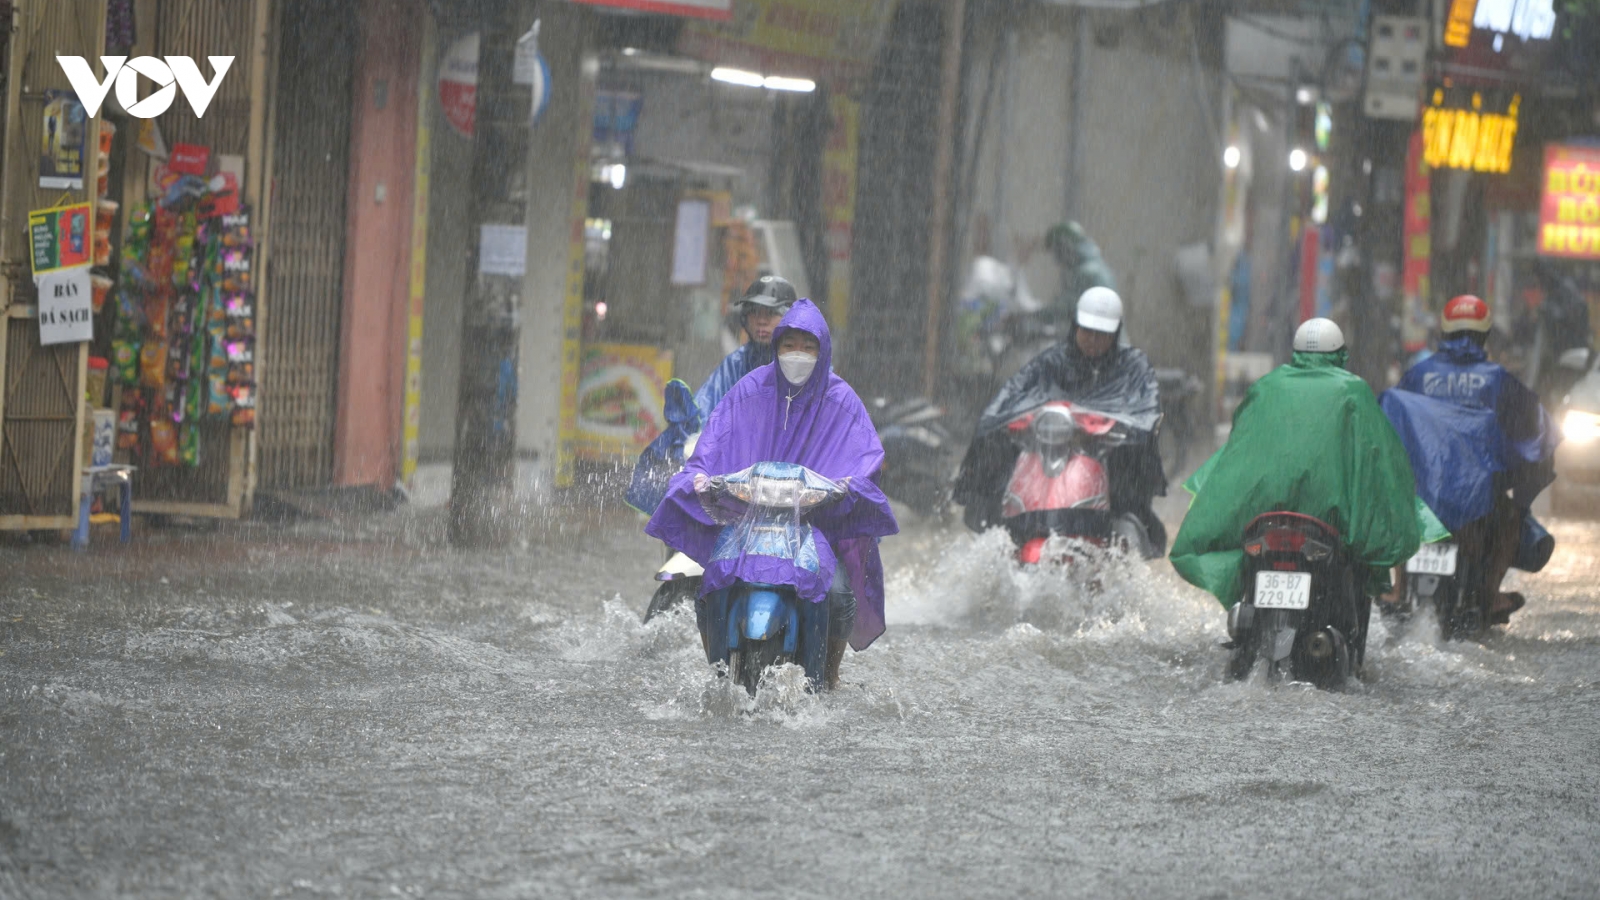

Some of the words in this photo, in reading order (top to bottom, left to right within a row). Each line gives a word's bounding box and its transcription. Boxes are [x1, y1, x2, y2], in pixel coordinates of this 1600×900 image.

[54, 281, 78, 298] BÁN
[60, 308, 89, 329] SẠCH
[1264, 574, 1303, 590] 36-B7
[1258, 590, 1305, 606] 229.44
